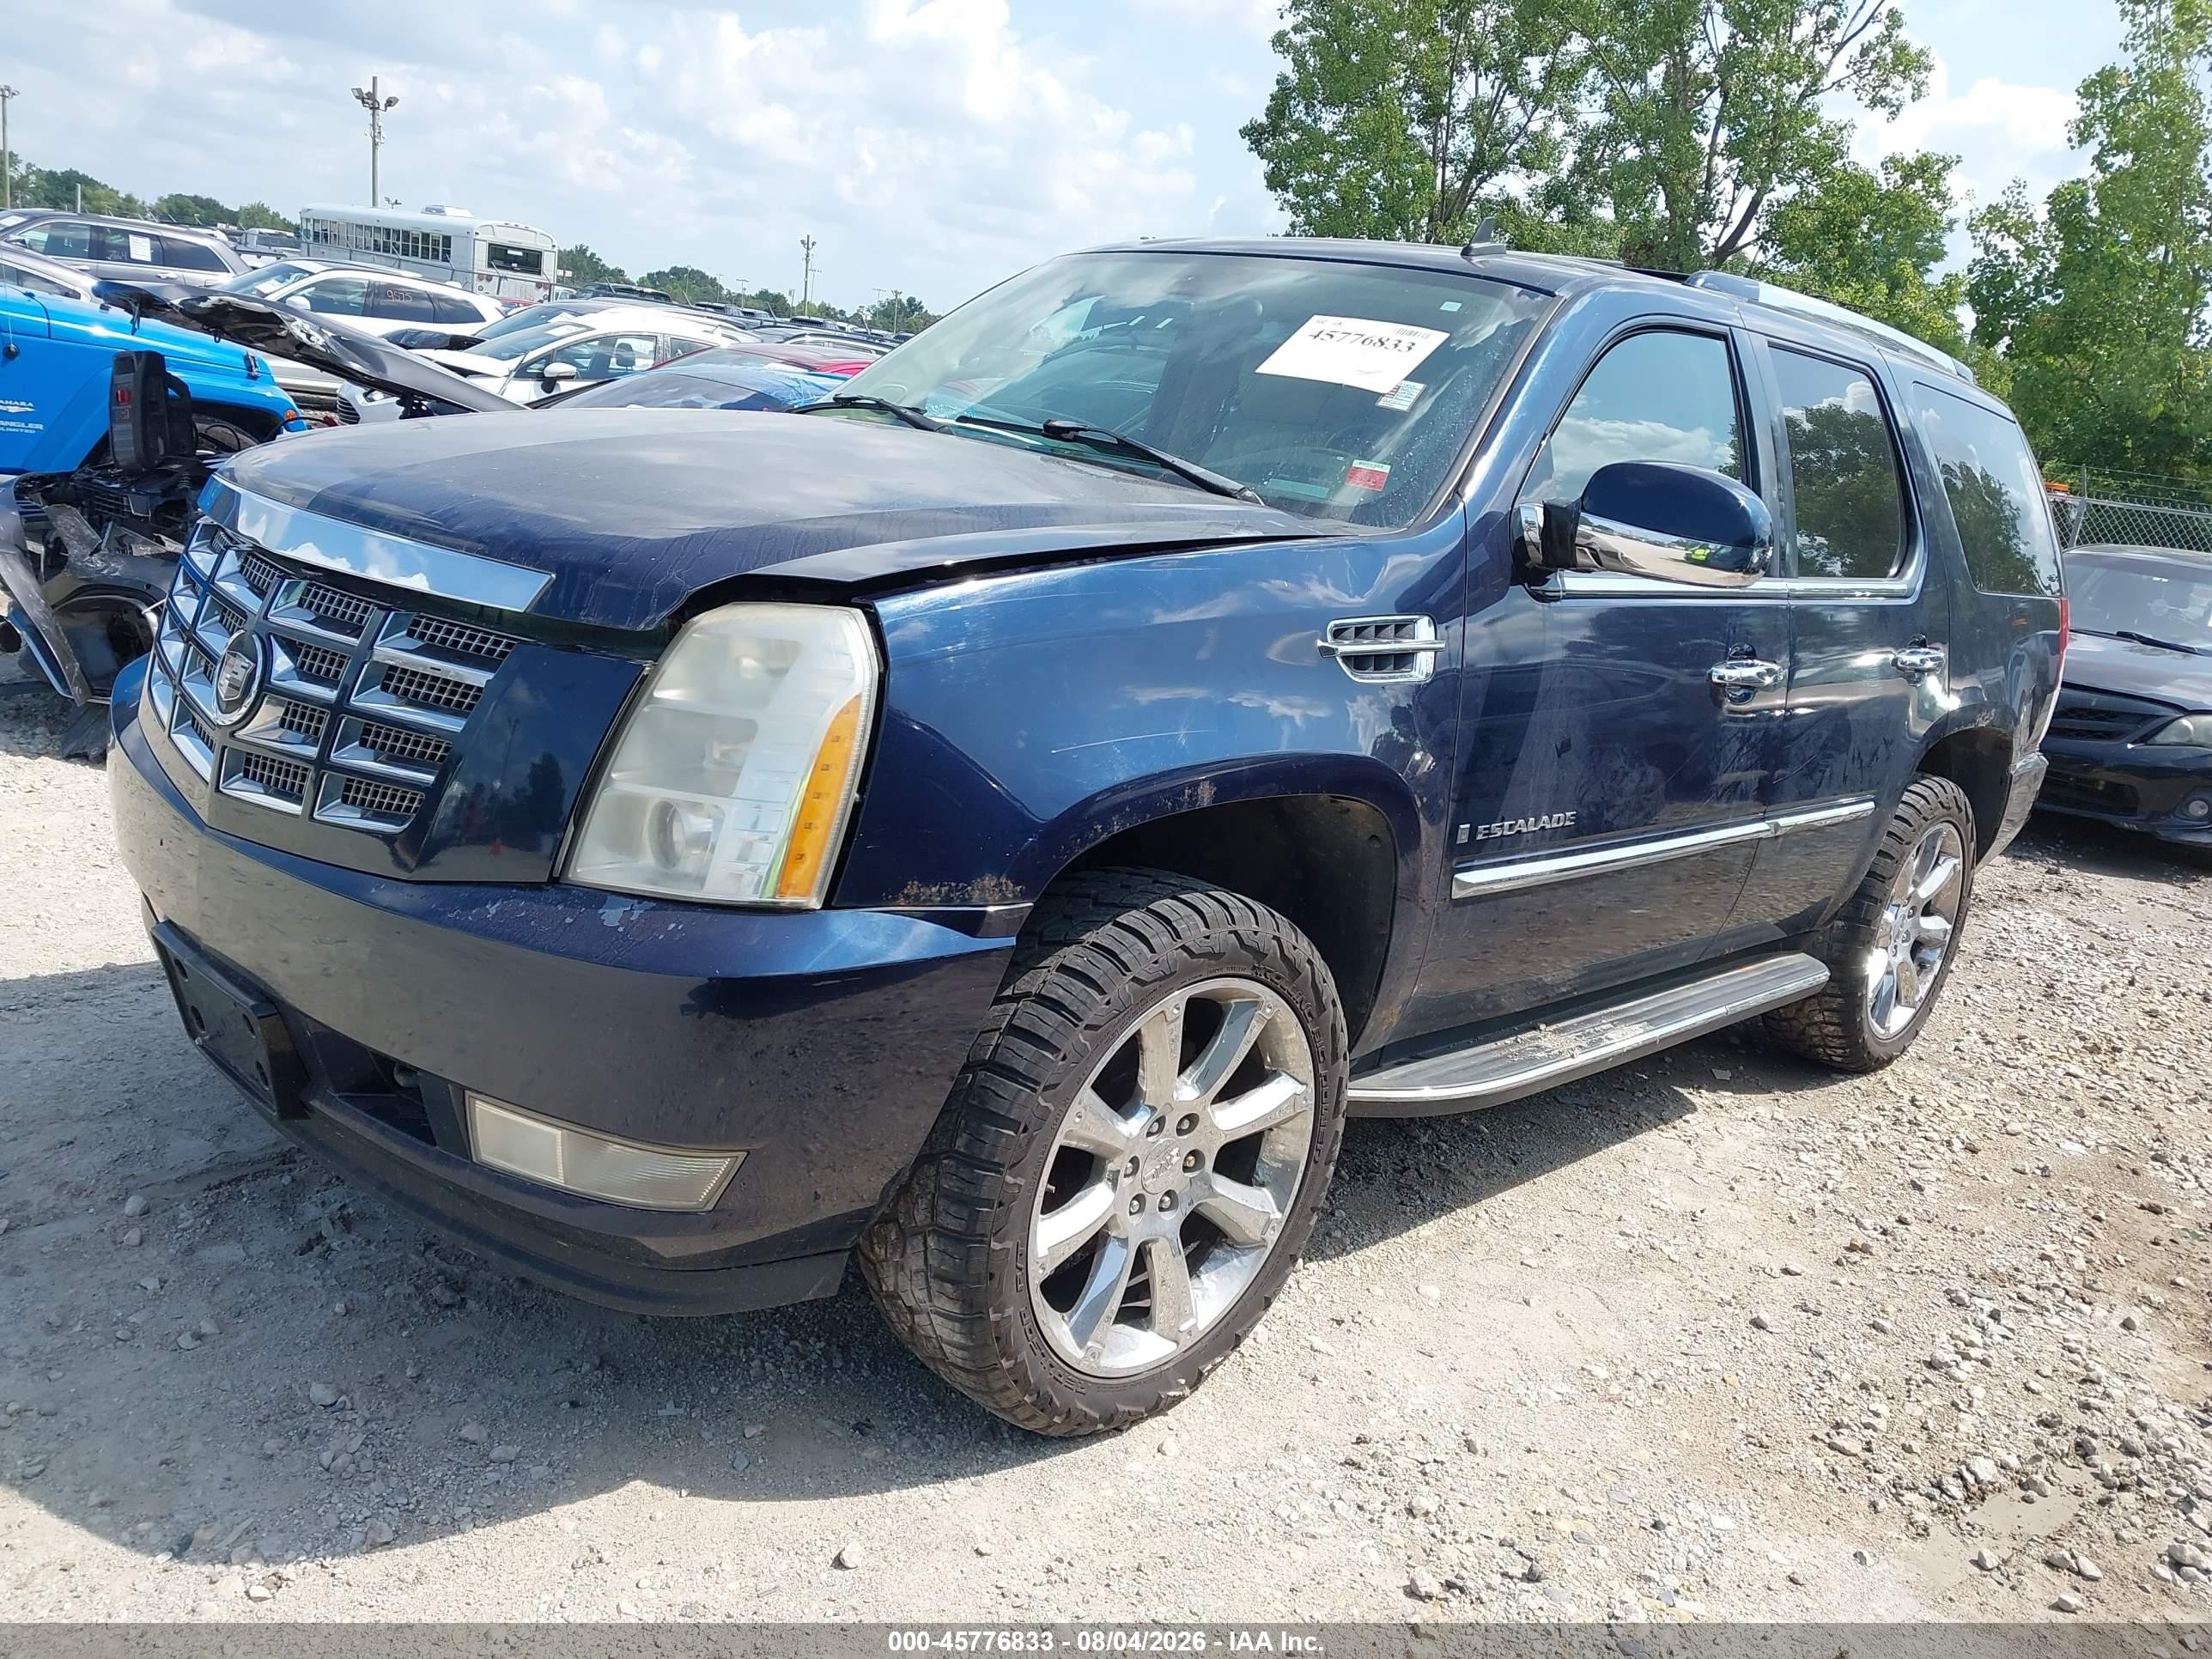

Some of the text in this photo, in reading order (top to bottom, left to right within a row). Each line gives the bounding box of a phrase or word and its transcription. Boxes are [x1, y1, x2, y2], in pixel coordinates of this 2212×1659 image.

[386, 289, 413, 302] 9575
[1308, 329, 1416, 354] 45776833
[1476, 811, 1577, 840] ESCALADE
